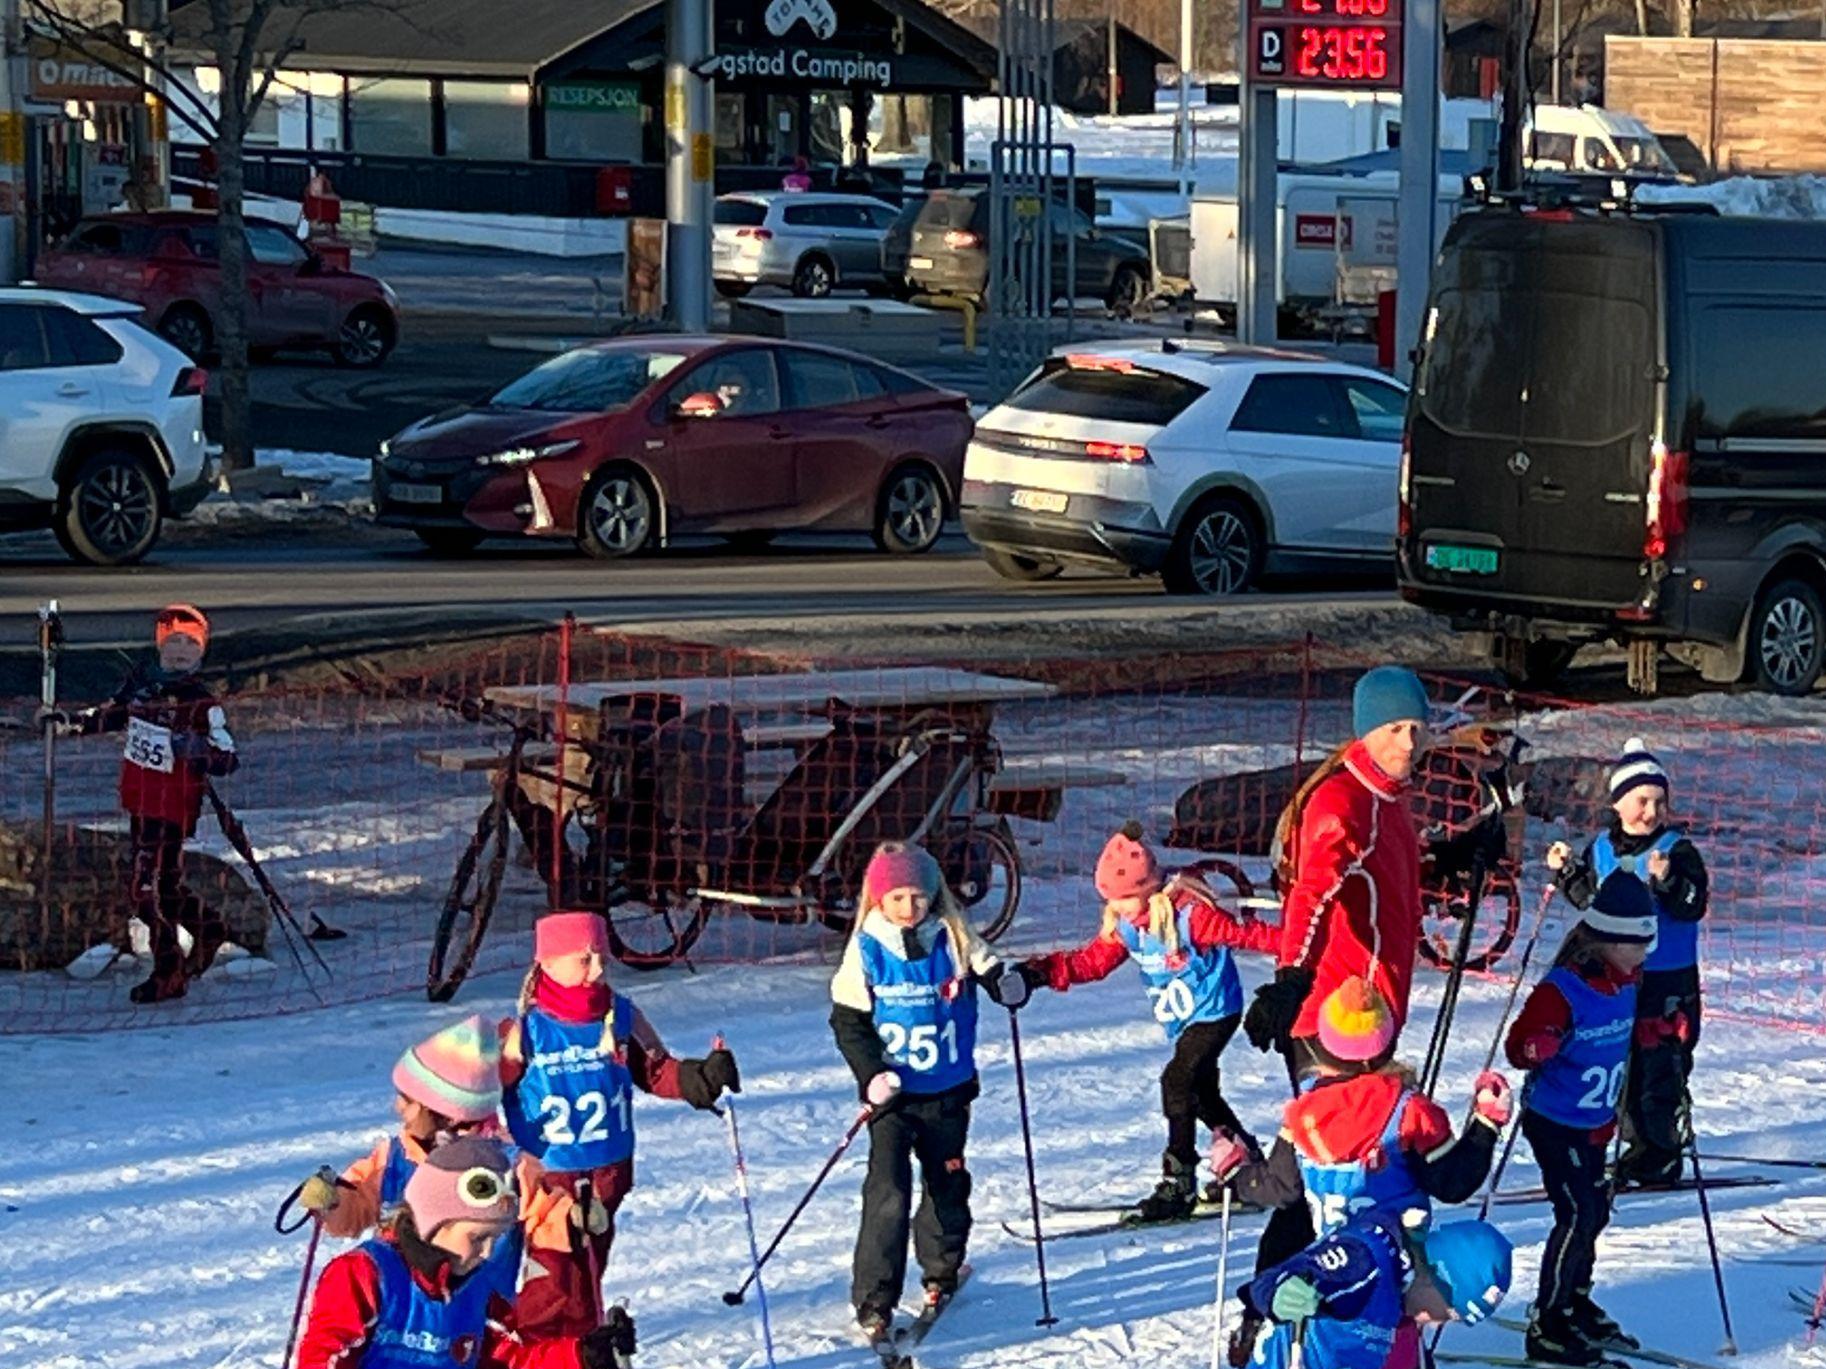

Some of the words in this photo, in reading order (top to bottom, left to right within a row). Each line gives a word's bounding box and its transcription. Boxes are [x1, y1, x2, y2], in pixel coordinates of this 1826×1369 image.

[1263, 30, 1280, 58] D
[792, 50, 891, 87] Camping
[878, 1018, 959, 1073] 251
[539, 1083, 629, 1145] 221
